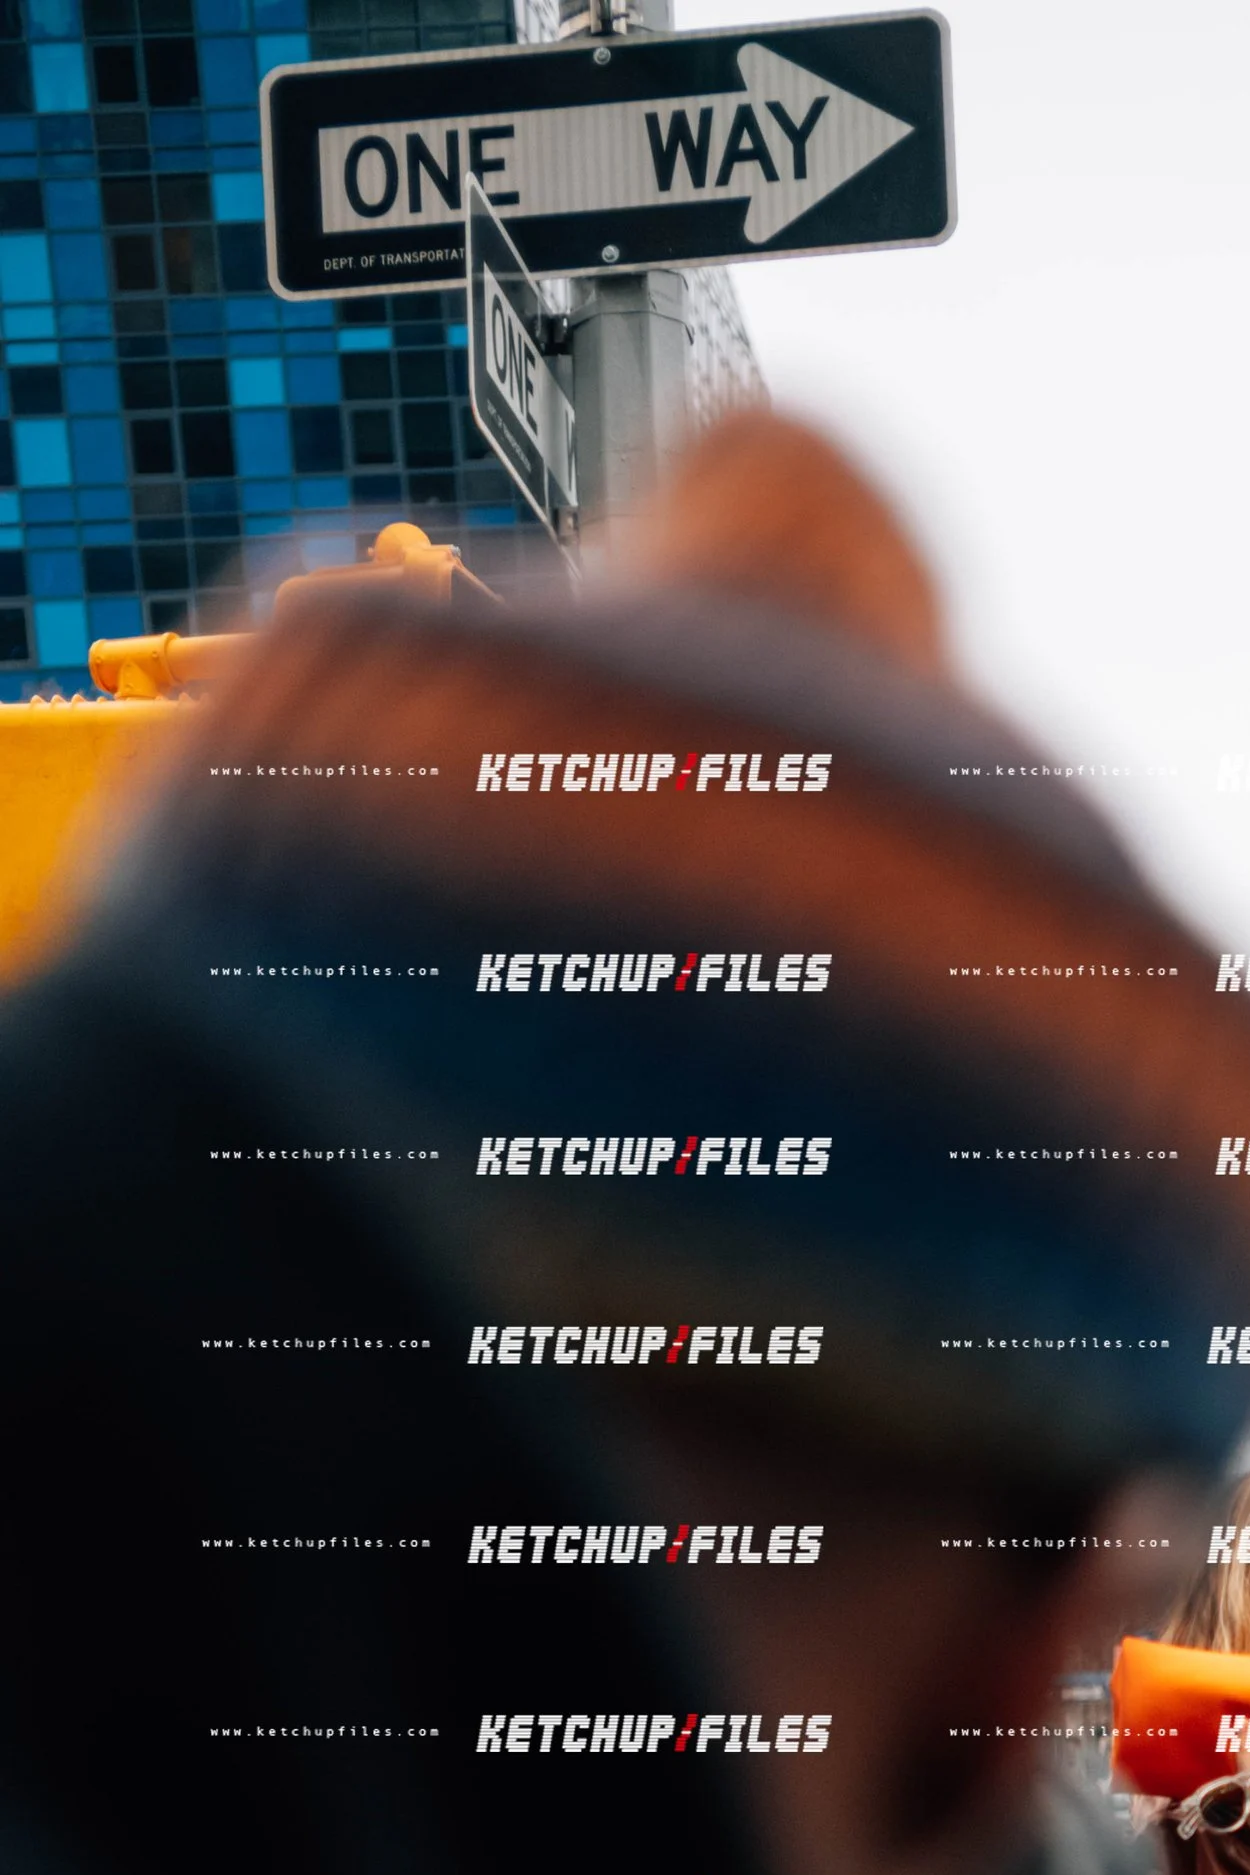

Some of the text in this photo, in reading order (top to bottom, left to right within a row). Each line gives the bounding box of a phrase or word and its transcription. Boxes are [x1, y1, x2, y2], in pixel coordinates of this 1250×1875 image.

[343, 95, 830, 218] ONE WAY
[324, 256, 356, 271] DEPT.
[360, 254, 376, 268] OF
[491, 293, 538, 436] ONE
